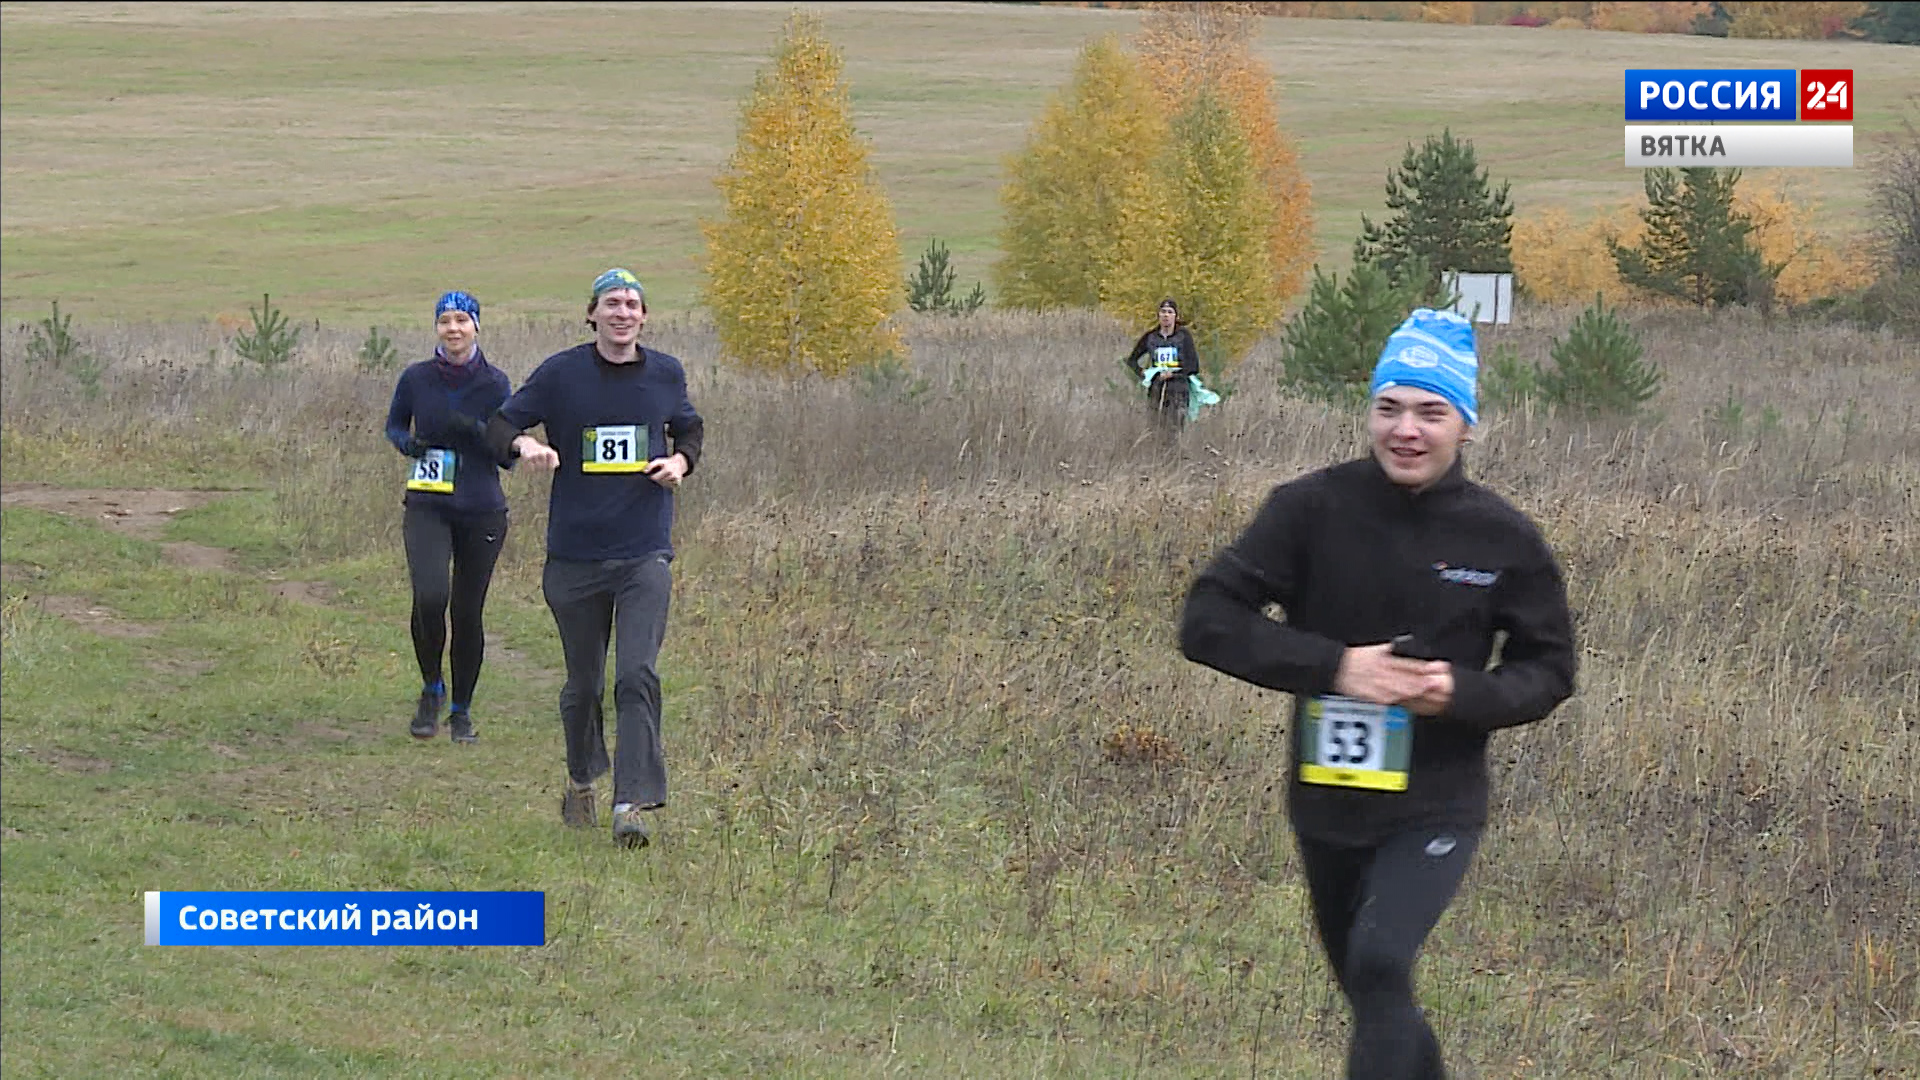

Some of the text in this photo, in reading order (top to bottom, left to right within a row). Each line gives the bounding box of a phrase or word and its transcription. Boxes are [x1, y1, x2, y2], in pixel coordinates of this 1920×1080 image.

[602, 439, 628, 461] 81
[417, 460, 439, 480] 58
[1328, 721, 1371, 764] 53
